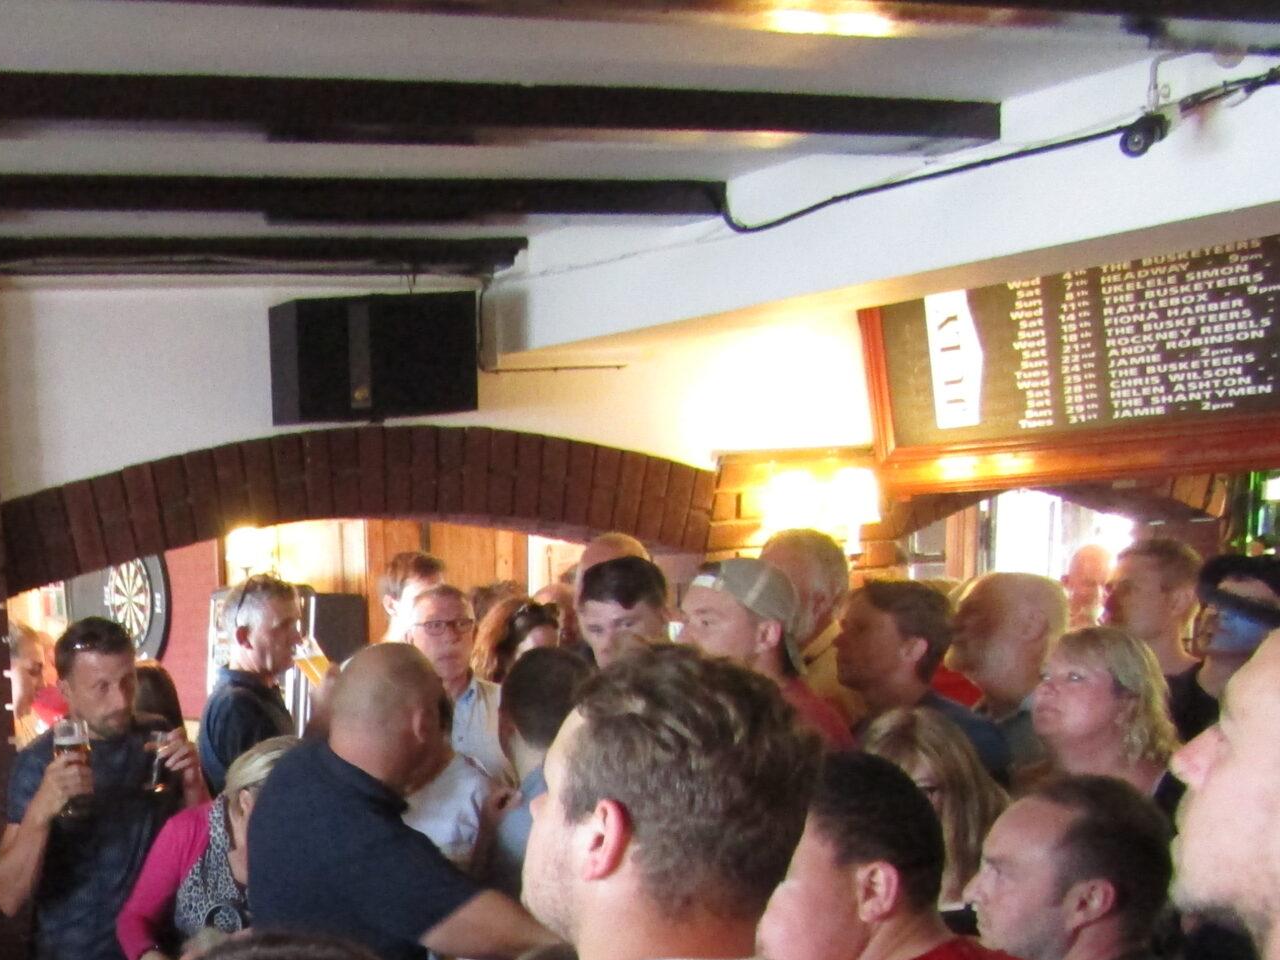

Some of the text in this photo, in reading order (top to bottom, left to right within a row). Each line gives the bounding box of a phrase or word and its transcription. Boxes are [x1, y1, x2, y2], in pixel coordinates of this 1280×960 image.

[1100, 261, 1190, 282] HEADWAY
[1229, 253, 1263, 263] 9pm
[1101, 274, 1177, 294] UKELELE
[1186, 264, 1249, 281] SIMON
[1103, 293, 1135, 305] THE
[1144, 272, 1264, 300] BUSKETEERS
[1103, 292, 1208, 316] RATTLEBOX
[1103, 311, 1159, 327] FIONA
[1167, 298, 1243, 317] HARBER
[1105, 325, 1135, 337] THE
[1142, 308, 1252, 332] BUSKETEERS
[1106, 328, 1192, 347] ROCKNEY
[1200, 317, 1271, 334] REBELS
[1108, 343, 1157, 357] ANDY
[1165, 329, 1264, 350] ROBINSON
[1108, 353, 1162, 368] JAMIE
[1201, 347, 1233, 357] 2pm
[1109, 368, 1138, 378] THE
[1145, 352, 1255, 375] BUSKETEERS
[1109, 376, 1160, 389] CHRIS
[1168, 366, 1243, 382] WILSON
[1110, 385, 1165, 399] HELEN
[1173, 376, 1252, 392] ASHTON
[1111, 397, 1143, 408] THE
[1150, 384, 1273, 405] SHANTYMEN
[1112, 406, 1166, 419] JAMIE
[1201, 401, 1234, 411] 2pm
